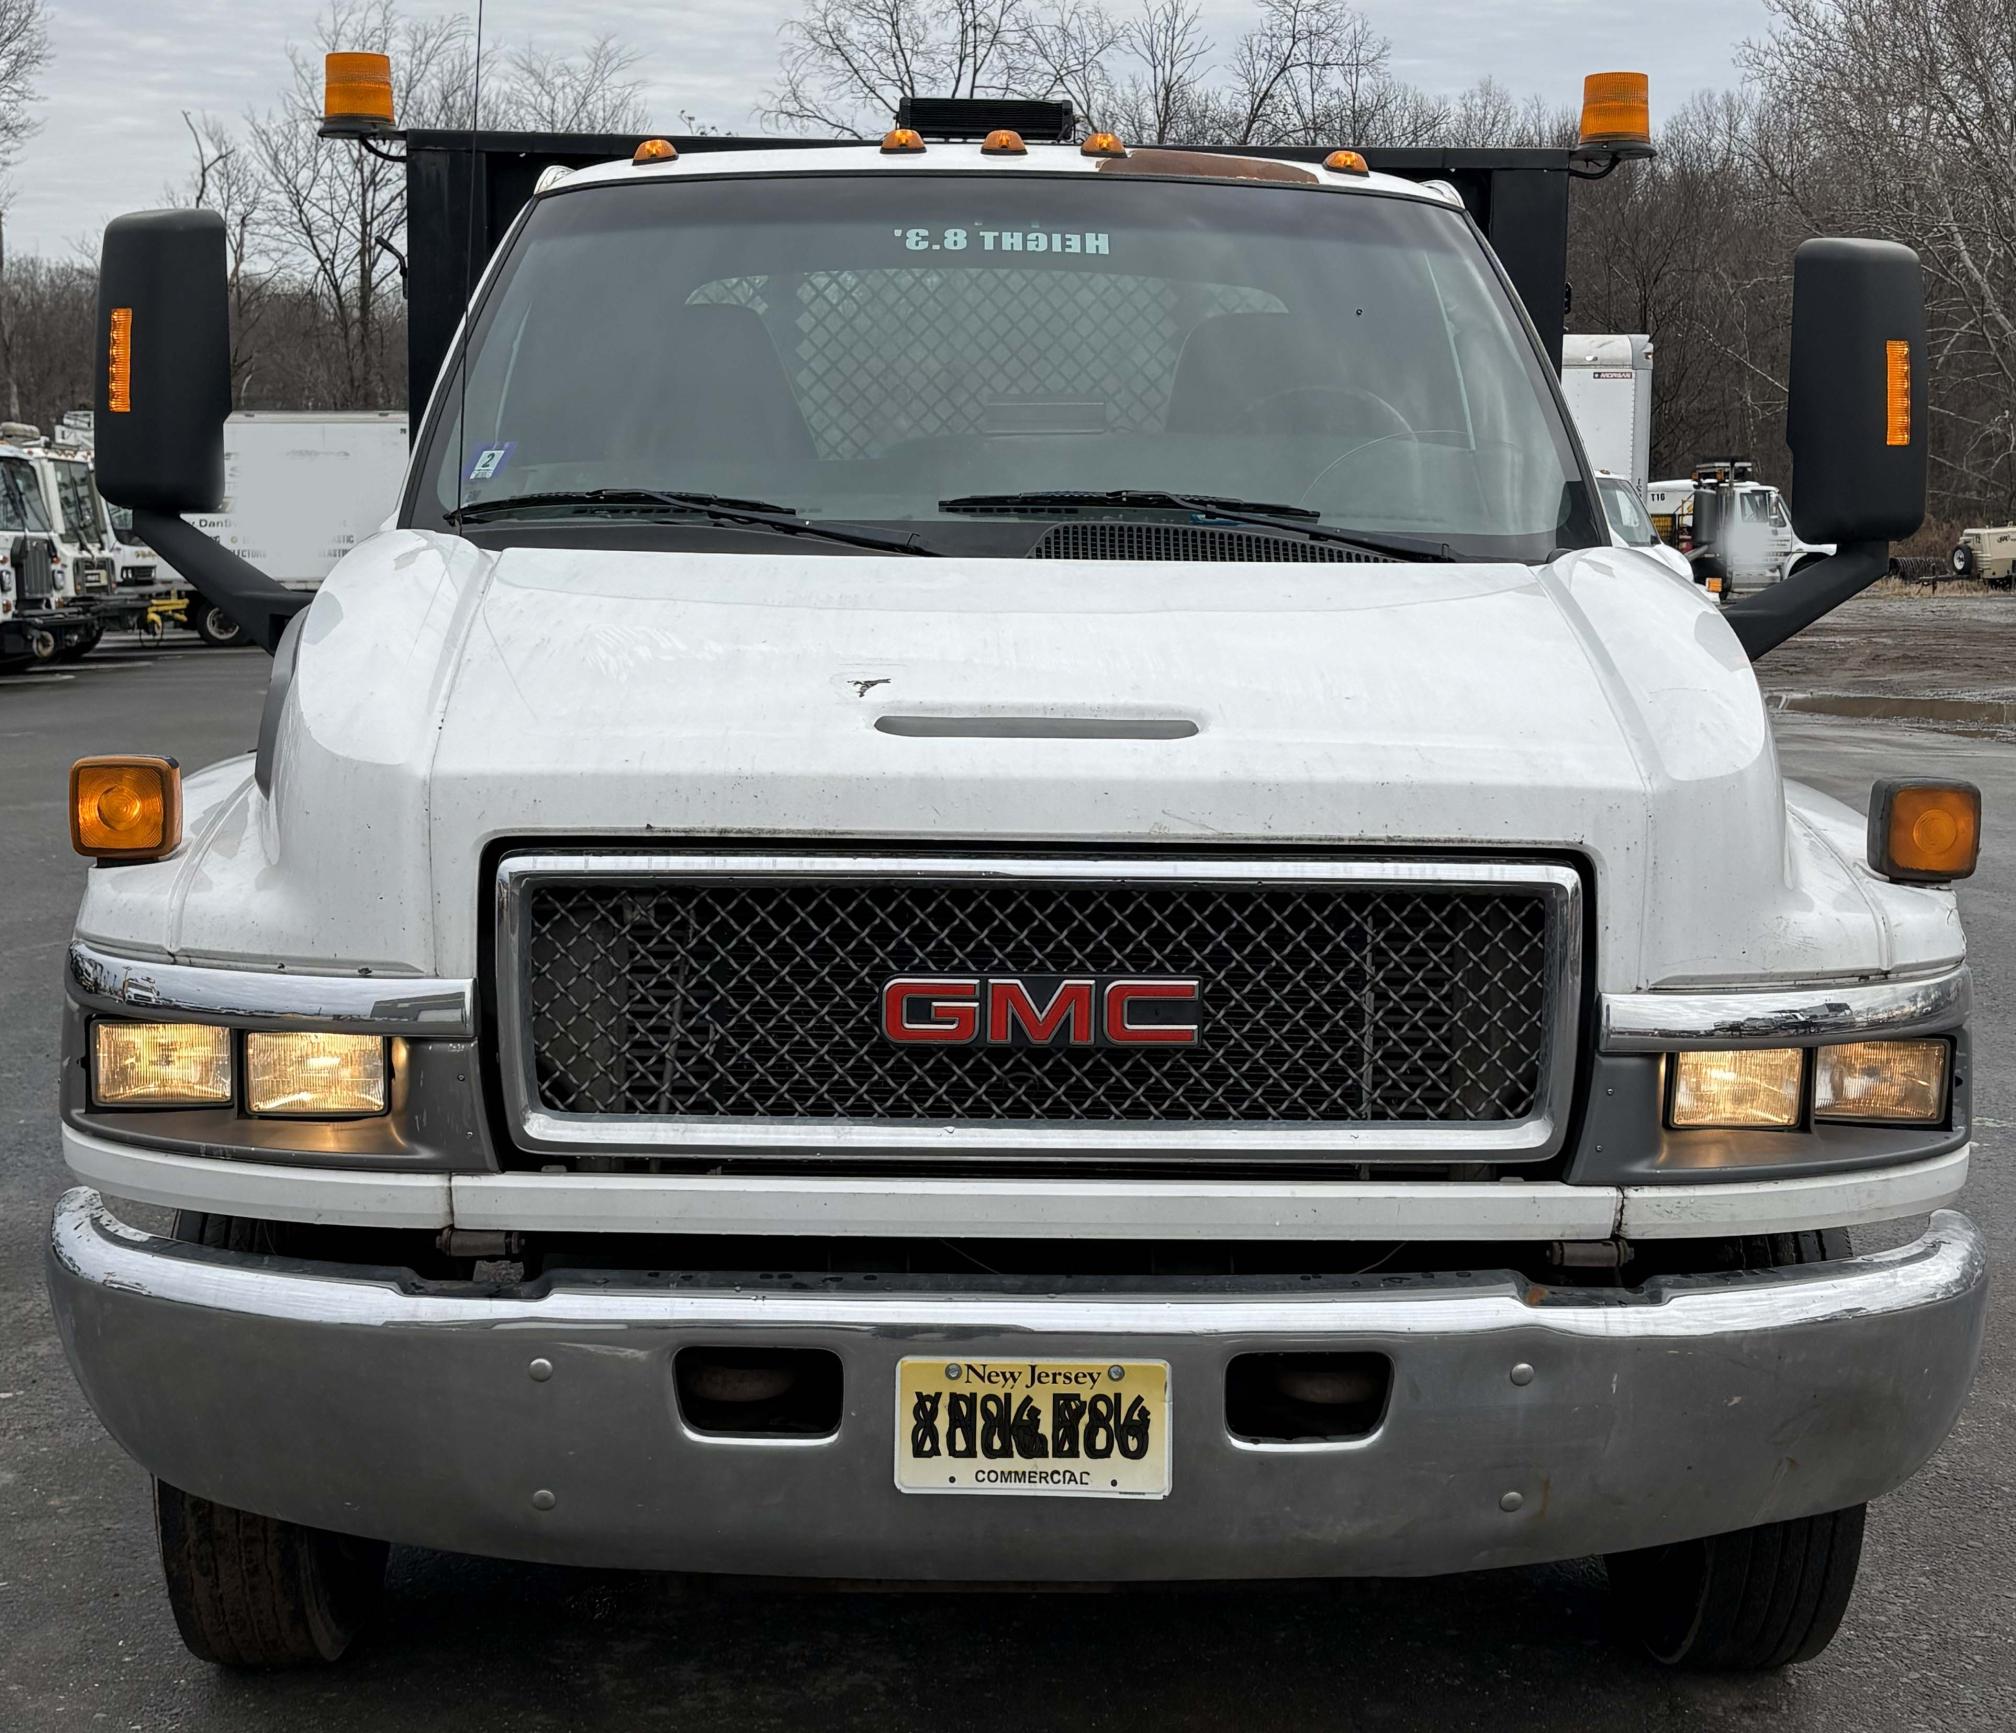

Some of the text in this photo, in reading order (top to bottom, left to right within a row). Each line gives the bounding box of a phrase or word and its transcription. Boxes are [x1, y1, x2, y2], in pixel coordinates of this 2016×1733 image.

[882, 978, 1199, 1044] GMC
[964, 1364, 1101, 1389] New Jersey
